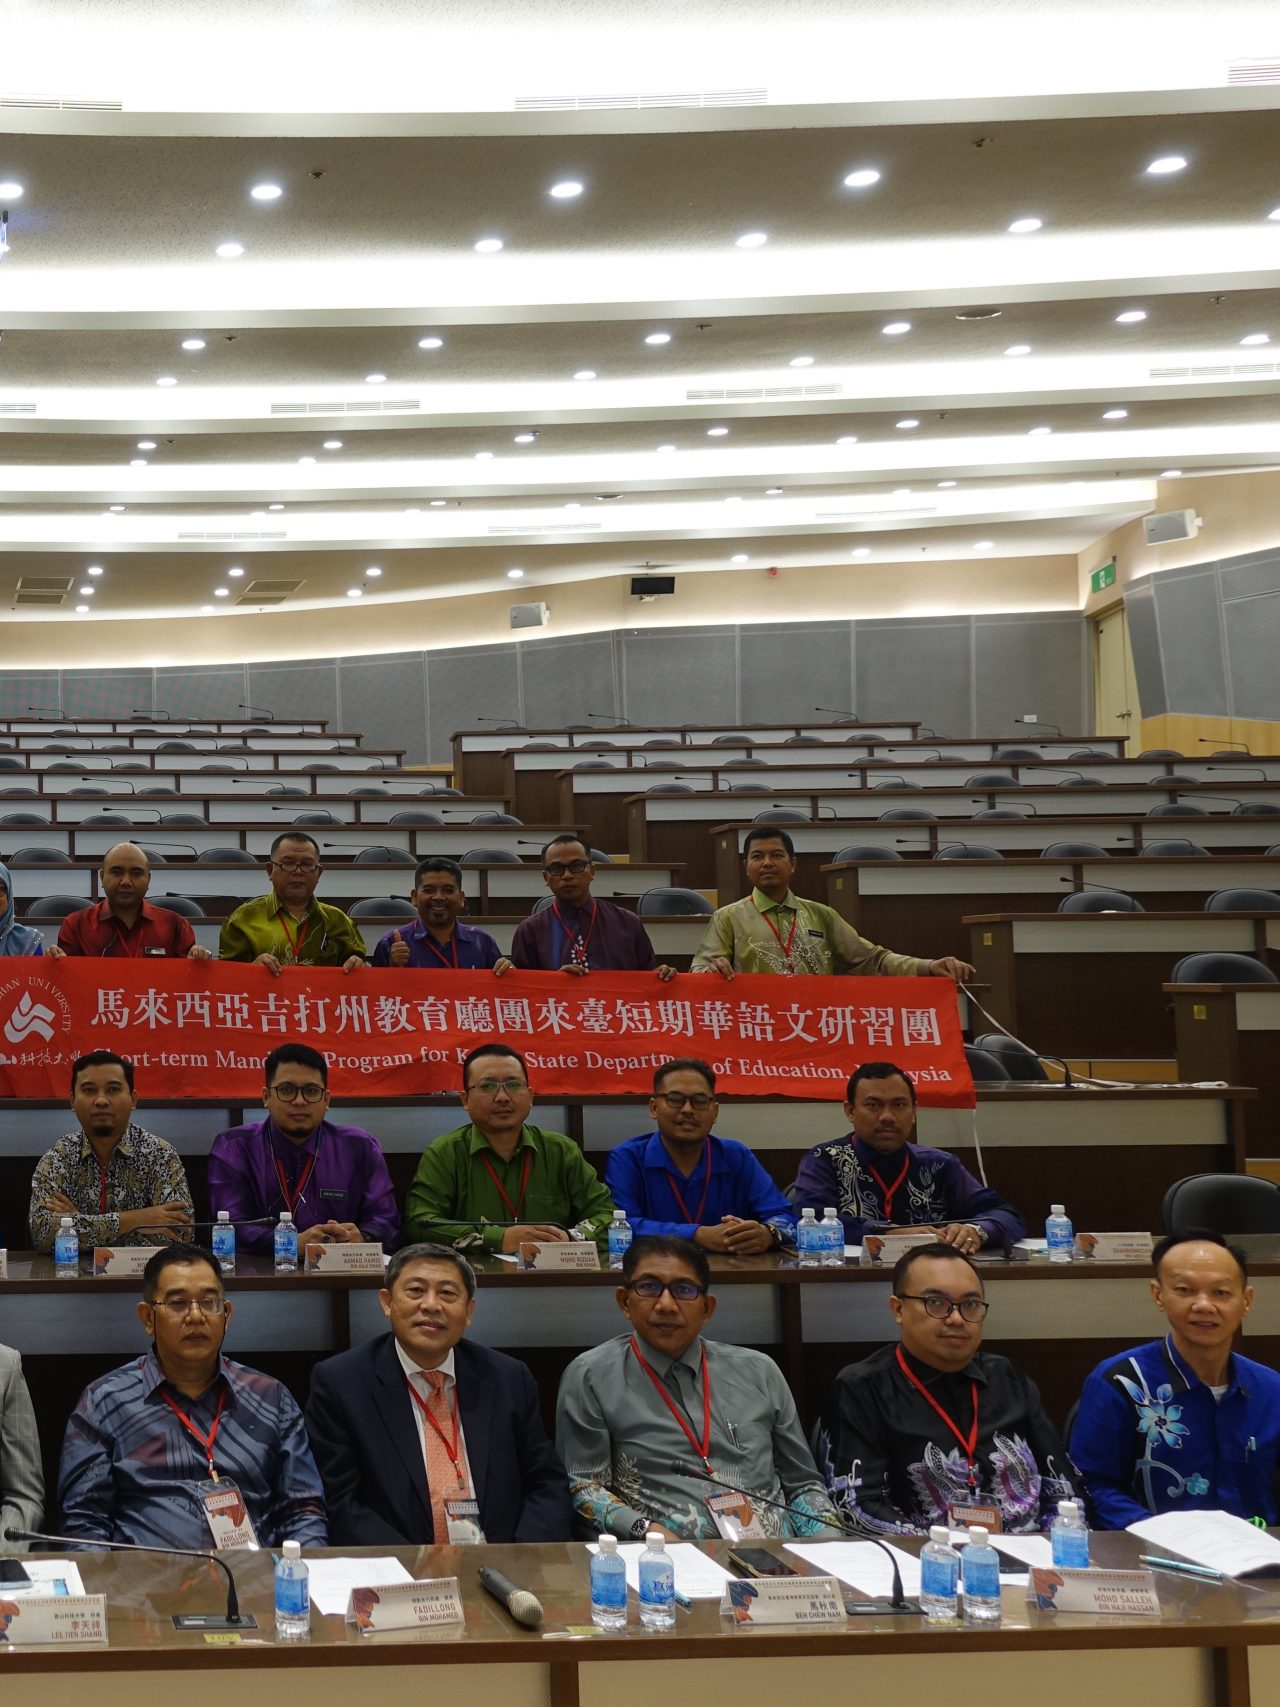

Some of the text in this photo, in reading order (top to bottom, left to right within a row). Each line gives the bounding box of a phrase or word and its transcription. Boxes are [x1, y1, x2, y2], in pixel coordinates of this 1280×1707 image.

[28, 976, 72, 1035] UNIVERSITY
[90, 988, 942, 1047] 馬來西亞吉打州教育廳團來臺短期華語文研習團
[323, 1051, 414, 1073] Program
[420, 1046, 450, 1063] for
[524, 1051, 579, 1070] State
[712, 1057, 733, 1076] of
[738, 1058, 851, 1080] Education,
[413, 1602, 456, 1615] FADILLONG
[1093, 1593, 1152, 1604] MOHD SALLEH
